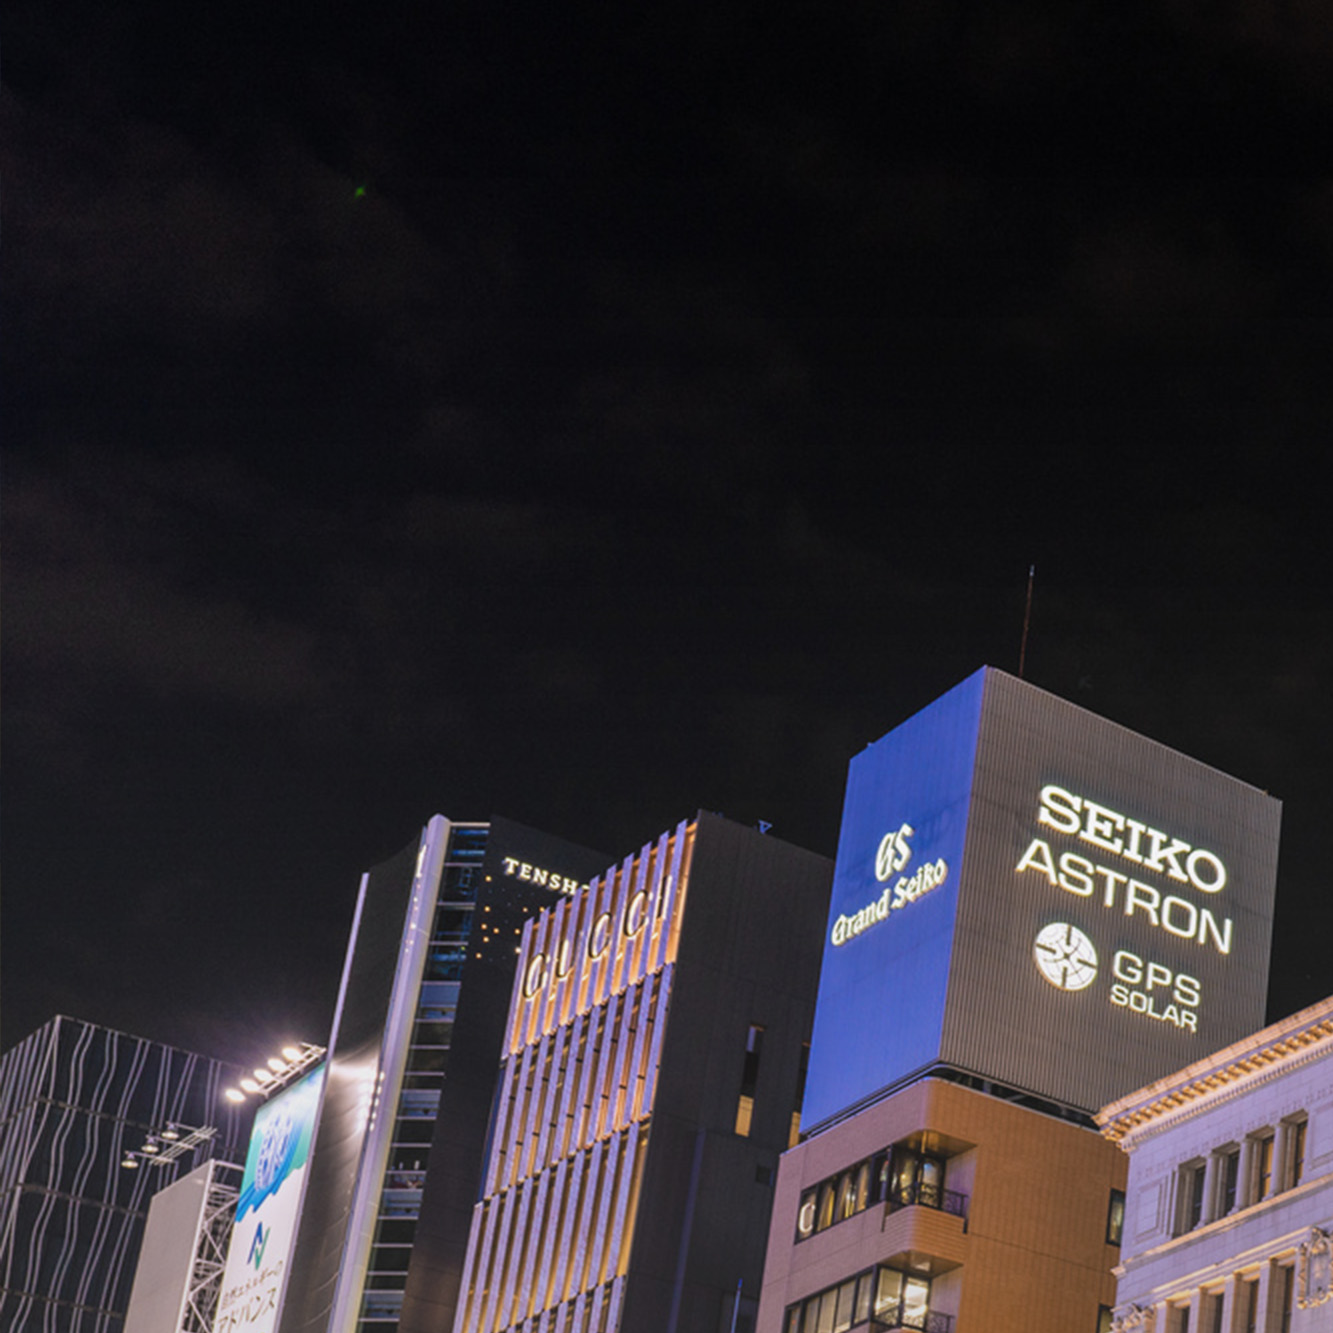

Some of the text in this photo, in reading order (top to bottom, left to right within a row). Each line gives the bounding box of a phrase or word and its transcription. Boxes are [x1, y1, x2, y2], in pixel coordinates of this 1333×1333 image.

[874, 822, 916, 883] GS
[1037, 783, 1228, 894] SEIKO
[520, 874, 673, 1002] GUCCI
[830, 857, 948, 947] Grand Seiko
[1015, 839, 1233, 956] ASTRON
[1109, 984, 1198, 1034] SOLAR
[1113, 949, 1202, 1009] GPS
